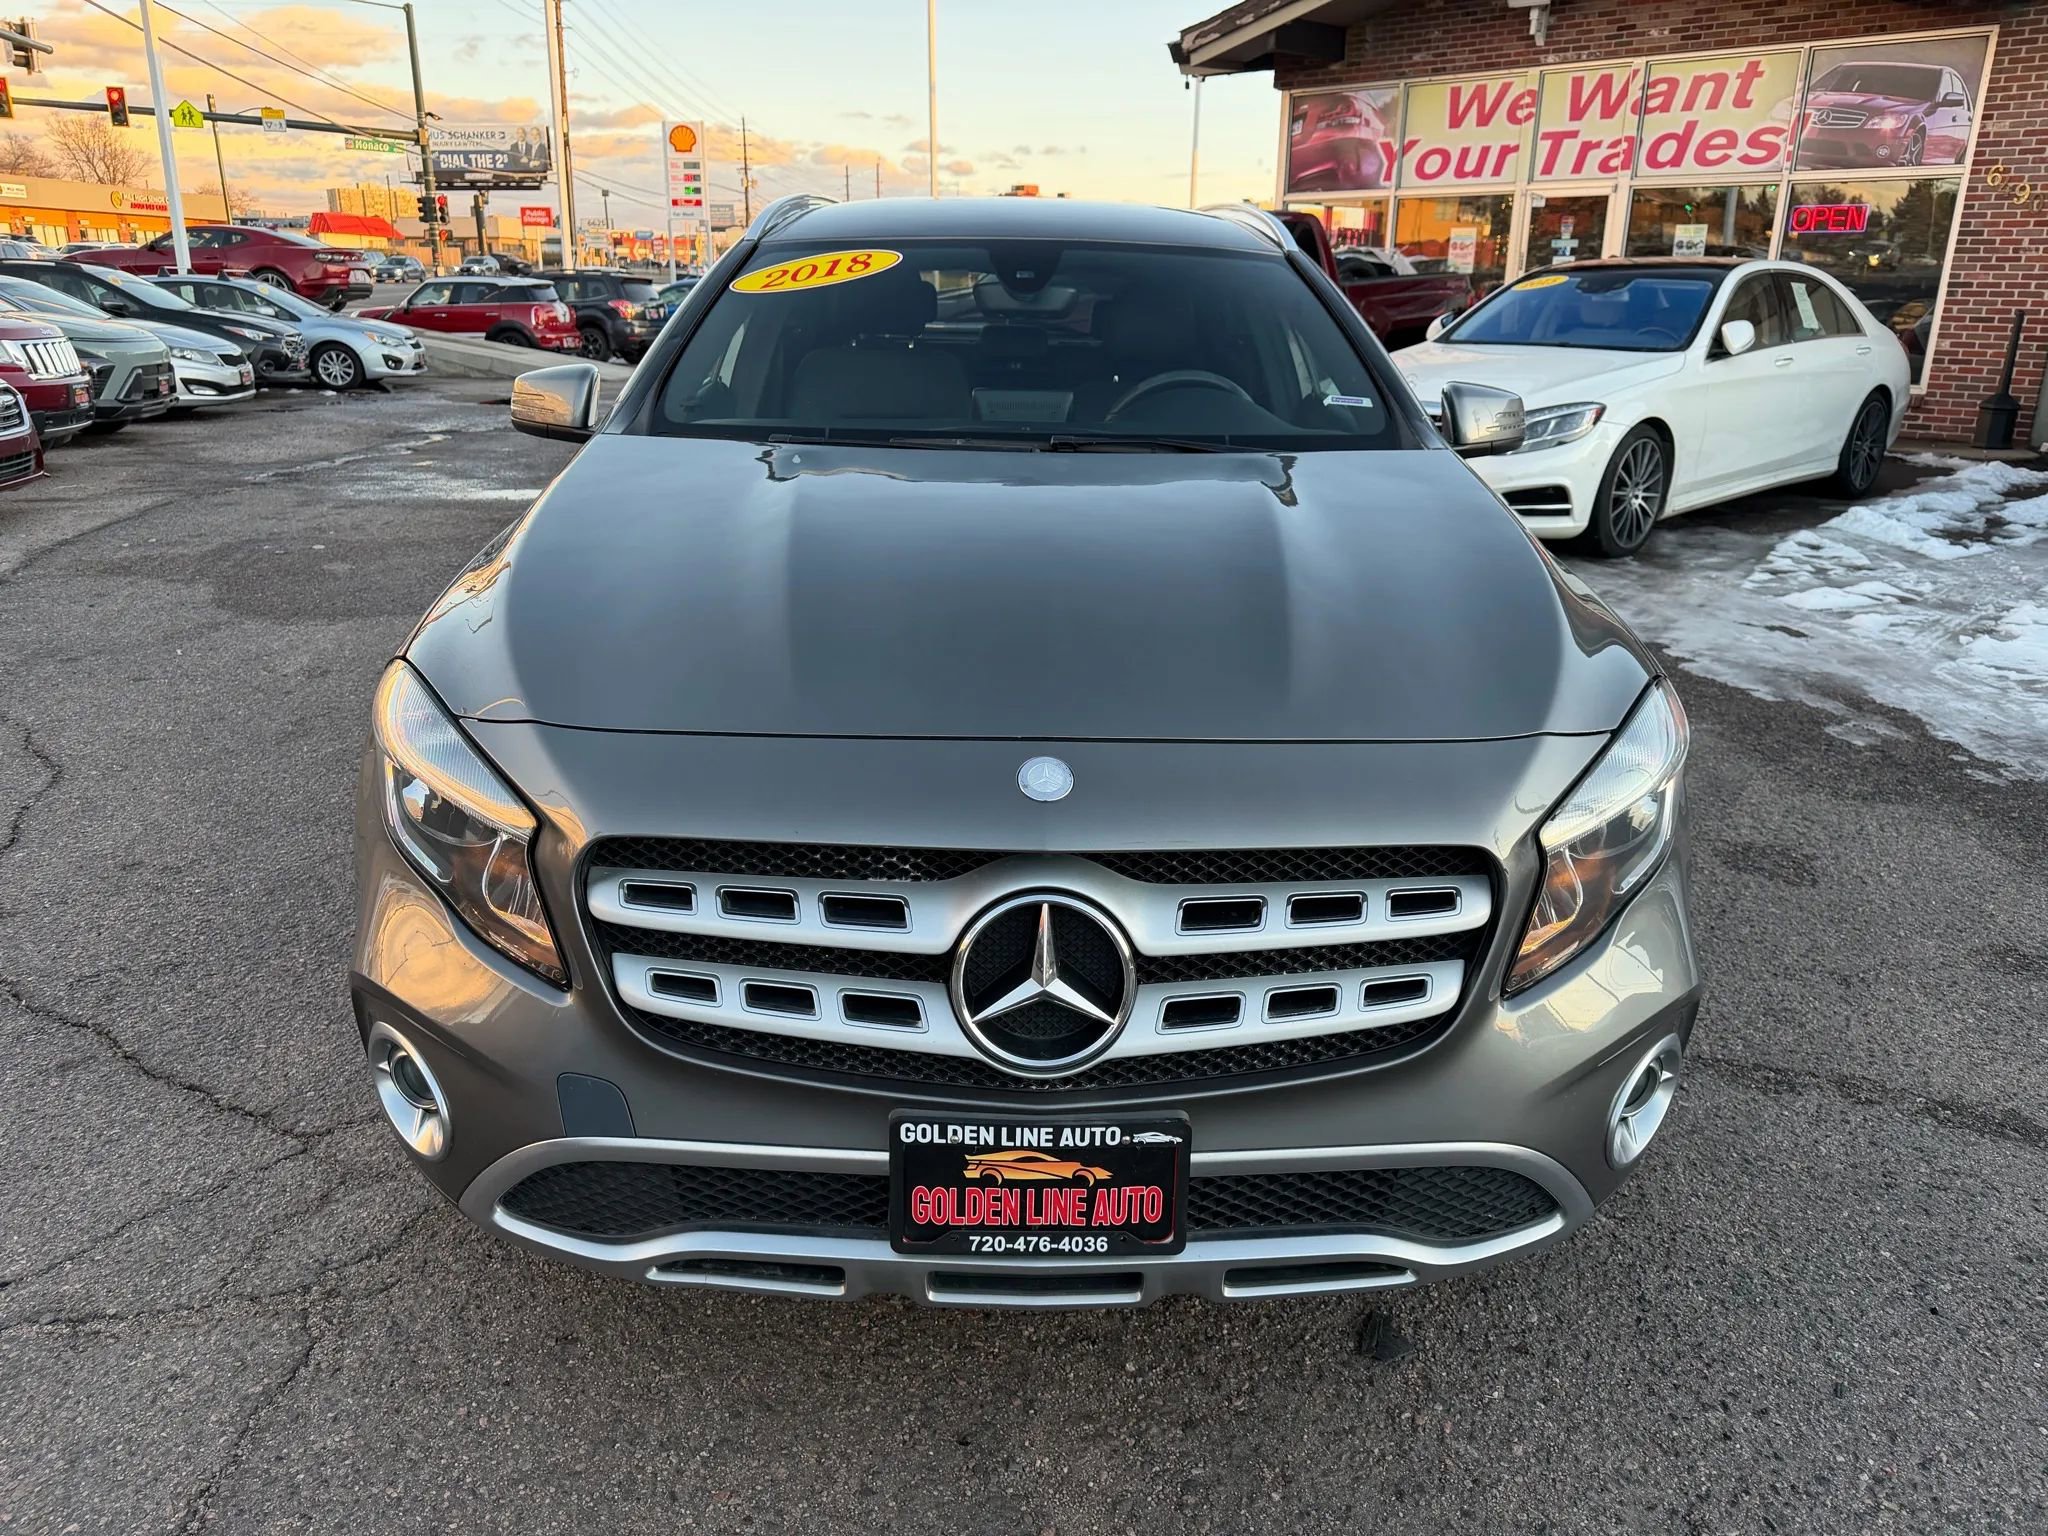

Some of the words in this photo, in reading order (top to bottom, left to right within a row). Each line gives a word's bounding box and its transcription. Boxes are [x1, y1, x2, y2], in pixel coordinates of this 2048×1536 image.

[1448, 80, 1537, 130] We
[1568, 59, 1765, 122] Want
[355, 139, 389, 152] Monaco
[447, 130, 496, 140] SCHANKER
[1378, 138, 1520, 183] Your
[1539, 112, 1812, 176] Trades!
[468, 153, 493, 169] THE
[1792, 206, 1868, 232] OPEN
[760, 253, 873, 290] 2018
[900, 1122, 994, 1147] GOLDEN
[1001, 1126, 1053, 1147] LINE
[1059, 1126, 1121, 1148] AUTO
[911, 1185, 1020, 1226] GOLDEN
[1026, 1188, 1087, 1226] LINE
[1092, 1185, 1163, 1227] AUTO
[969, 1235, 1108, 1253] 720-476-4036
